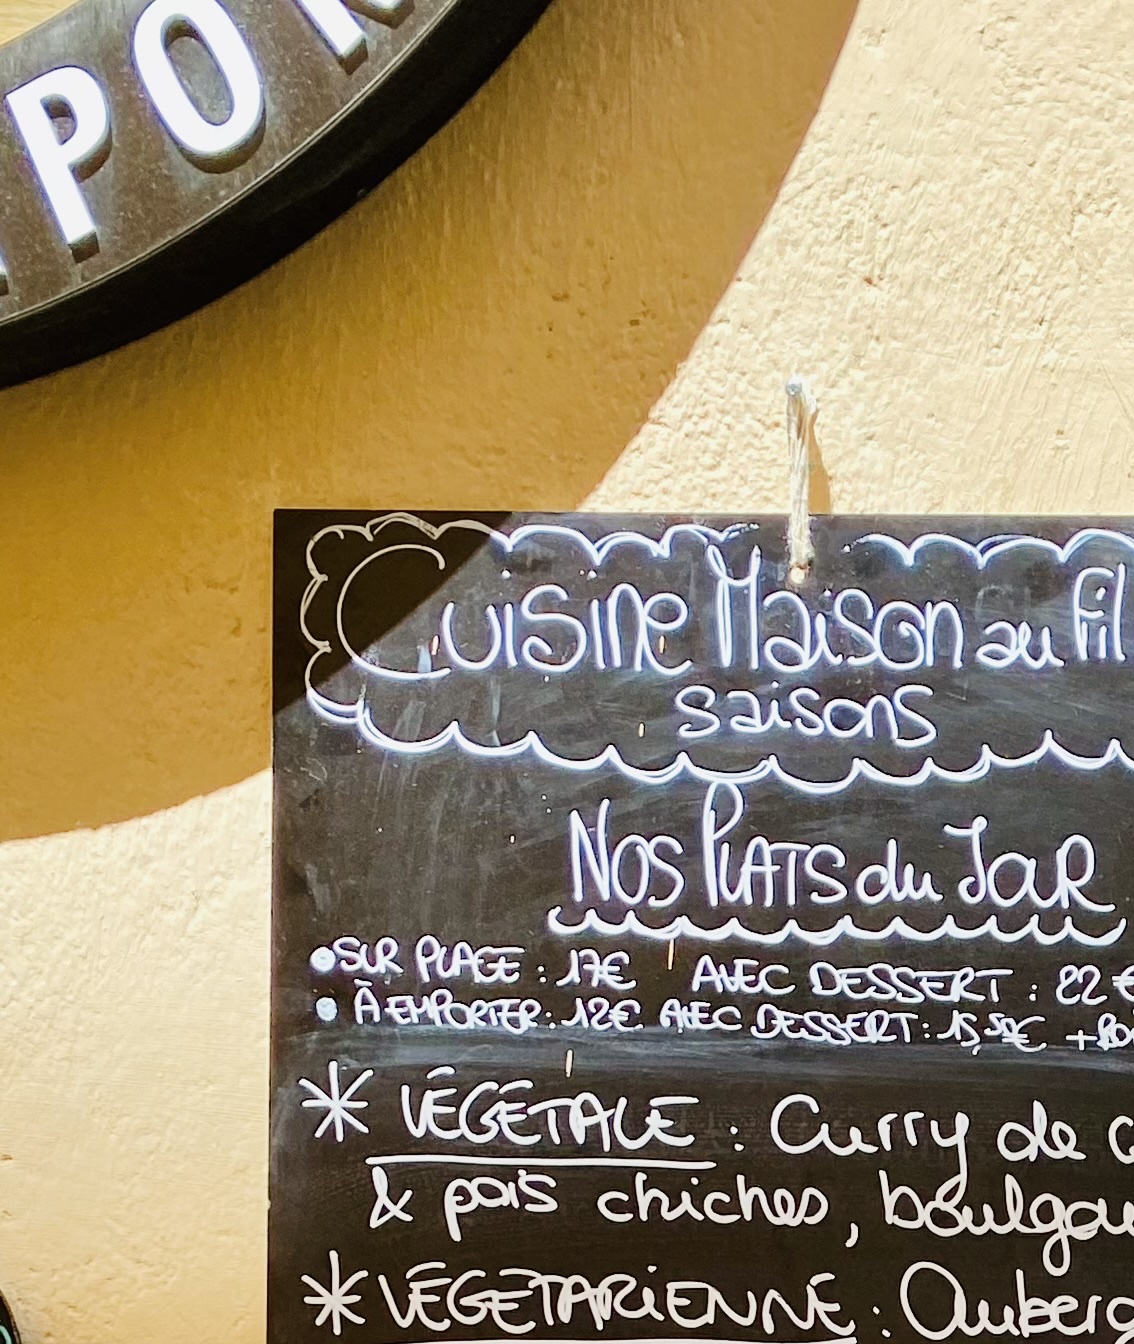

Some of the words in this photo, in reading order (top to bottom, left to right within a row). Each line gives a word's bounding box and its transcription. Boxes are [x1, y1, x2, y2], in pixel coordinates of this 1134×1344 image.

[975, 617, 1064, 668] au
[674, 684, 937, 749] saisons
[333, 936, 403, 974] SUR
[415, 935, 526, 984] PLACE
[693, 955, 796, 995] AVEC
[808, 963, 1014, 1002] DESSERT
[660, 1000, 743, 1033] AVEC
[771, 1093, 970, 1204] Curry
[996, 1099, 1086, 1163] de
[369, 1165, 415, 1229] &
[444, 1168, 558, 1242] pois
